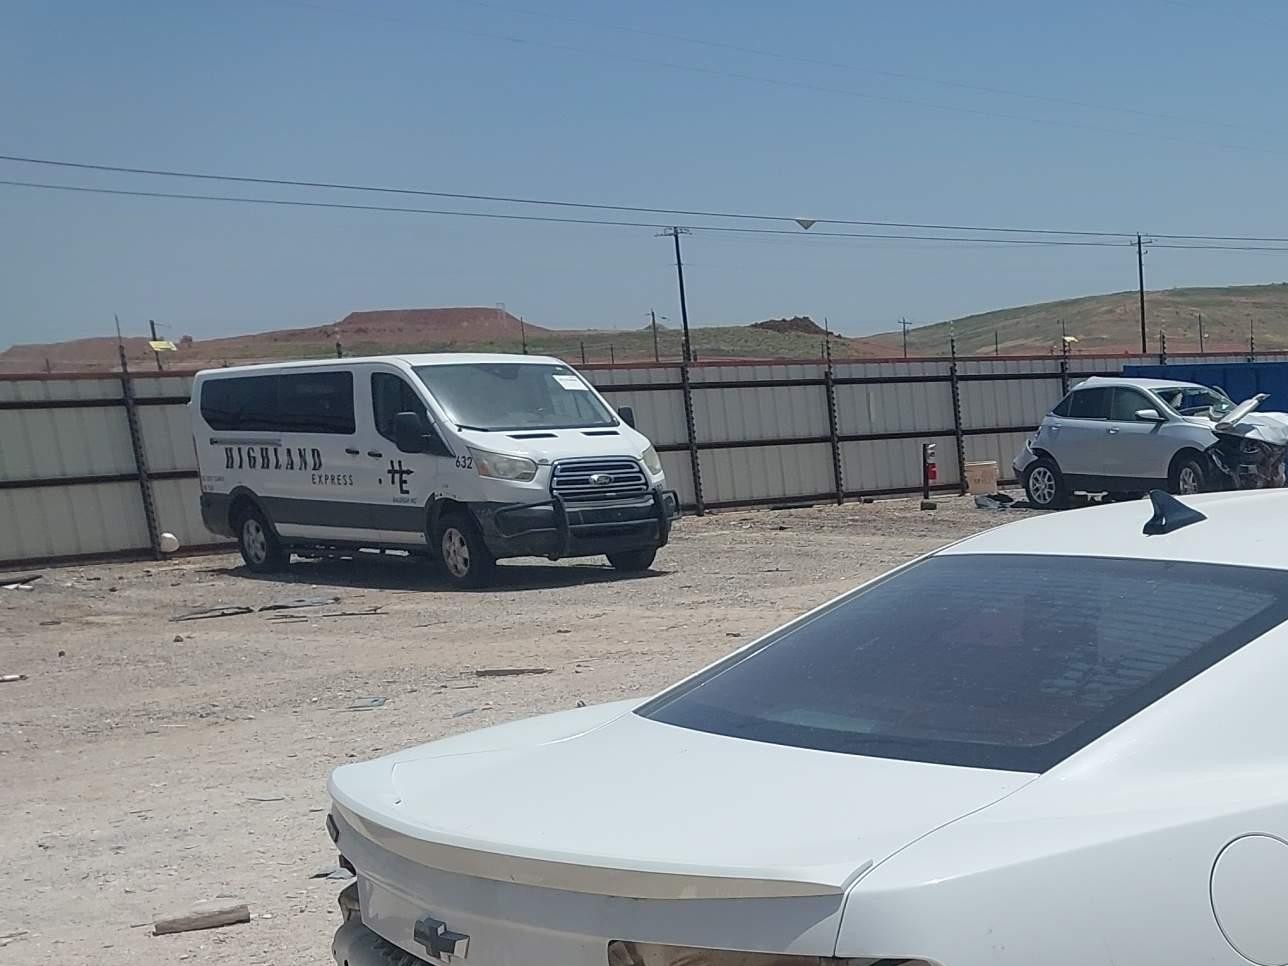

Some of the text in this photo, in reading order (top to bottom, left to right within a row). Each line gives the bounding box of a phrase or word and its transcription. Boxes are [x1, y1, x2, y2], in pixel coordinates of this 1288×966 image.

[224, 446, 323, 471] HIGHLAND
[455, 455, 473, 469] 632
[311, 473, 354, 486] EXPRESS
